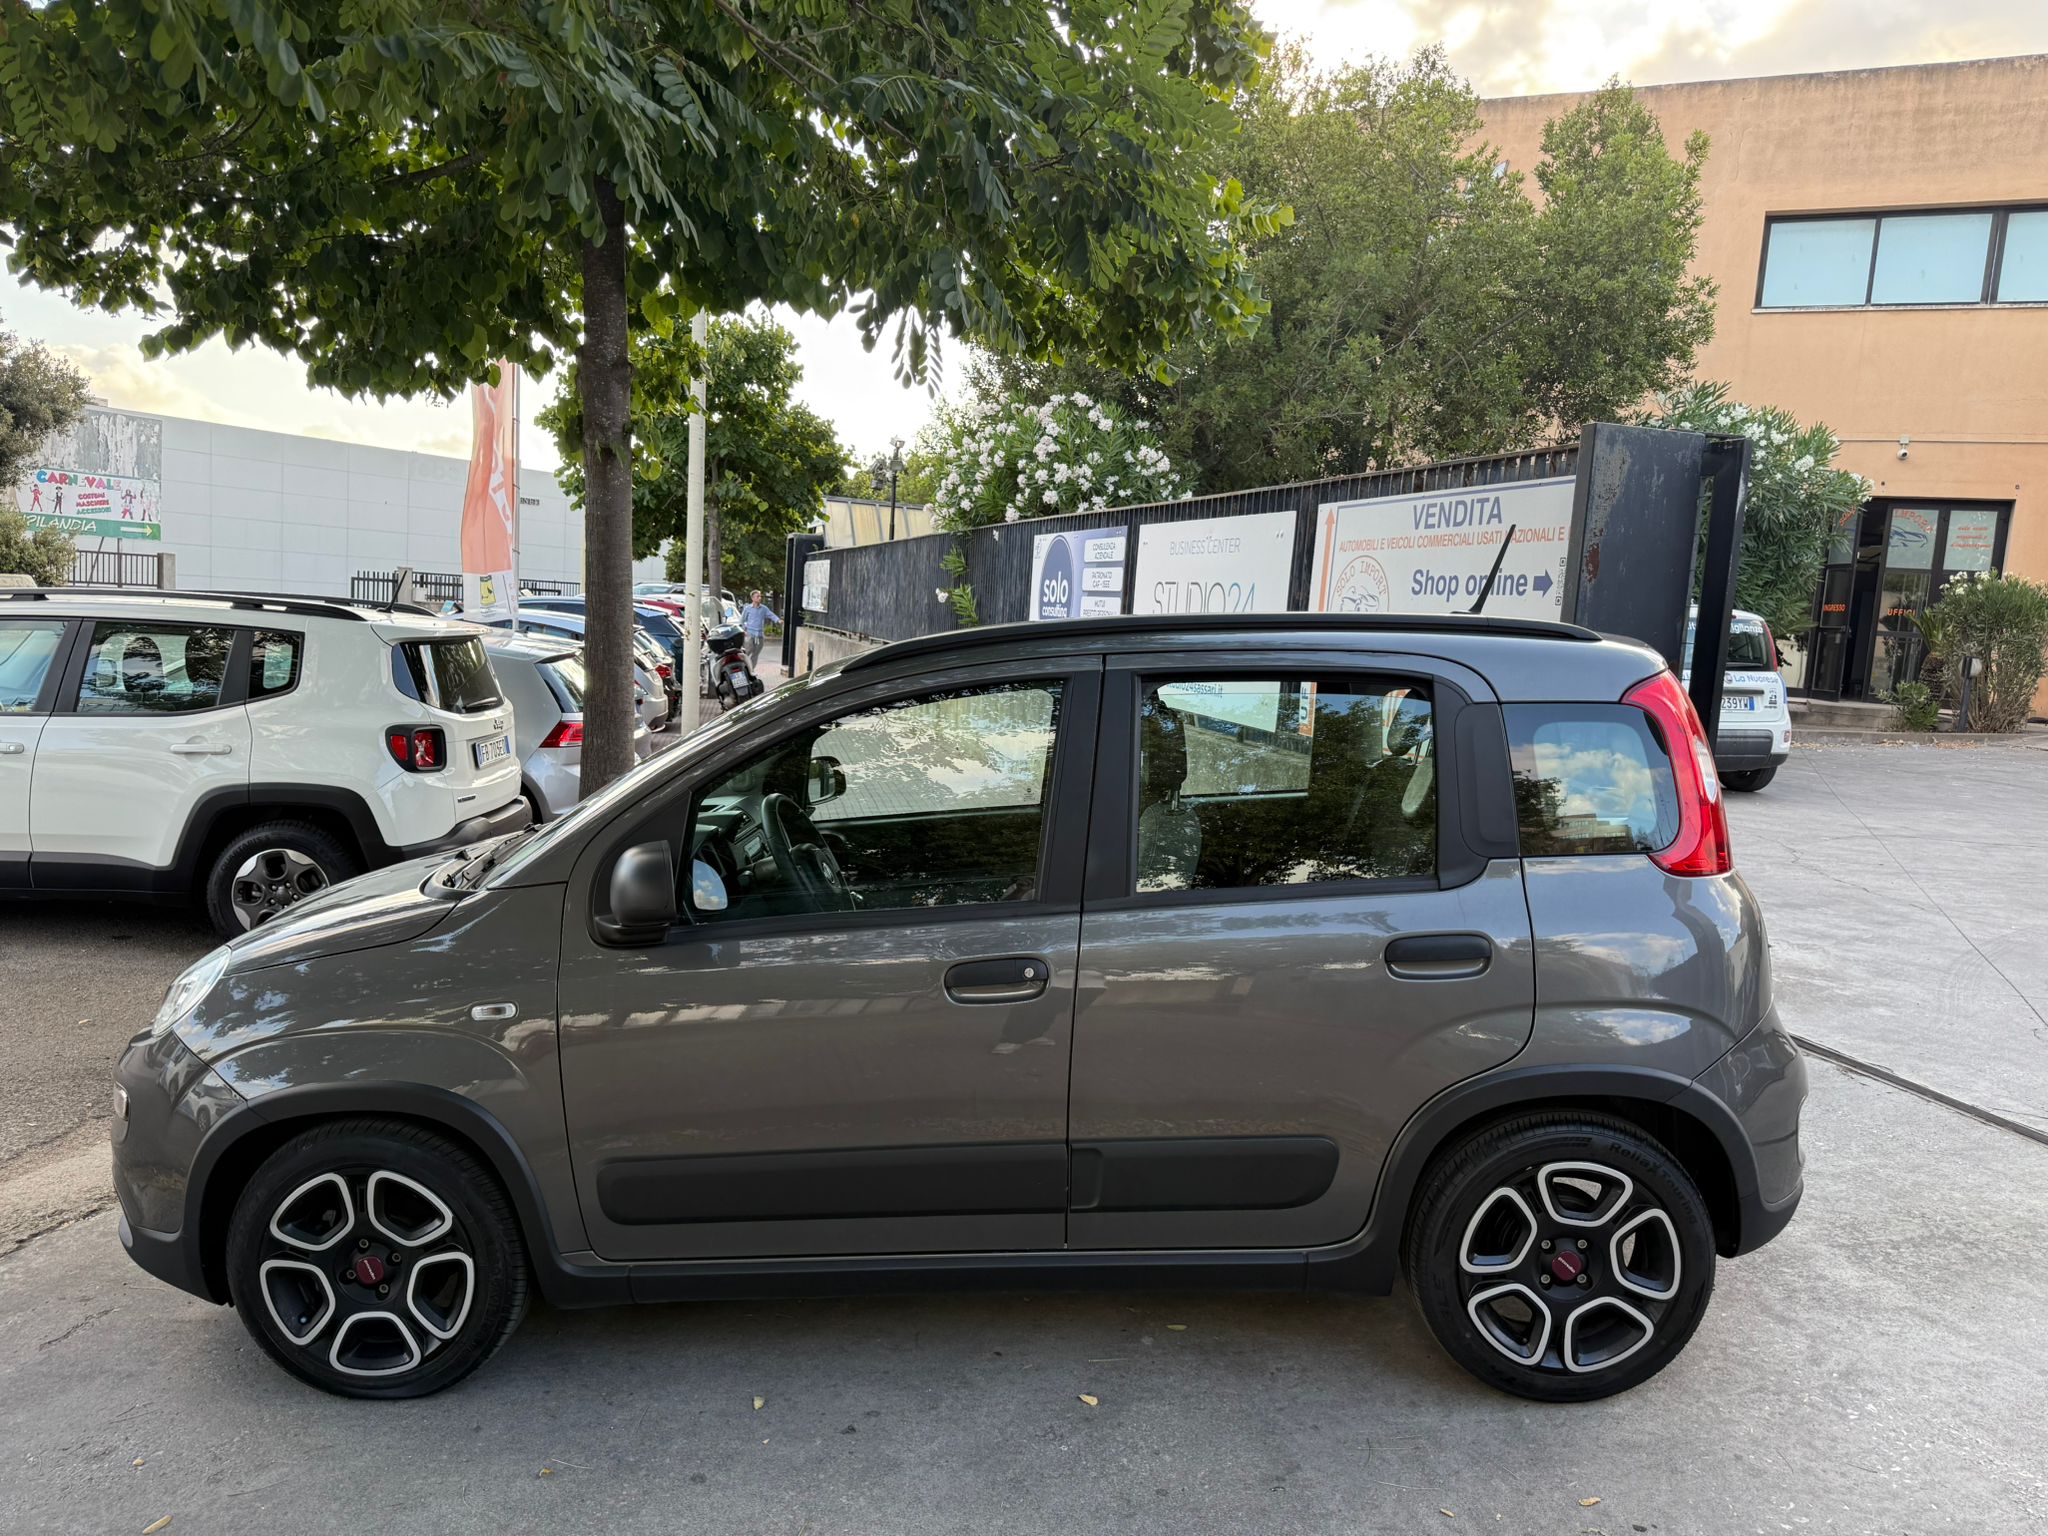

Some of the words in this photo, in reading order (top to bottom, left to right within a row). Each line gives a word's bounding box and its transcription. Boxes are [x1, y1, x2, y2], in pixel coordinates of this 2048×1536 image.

[36, 470, 121, 491] CARNEVALE
[1413, 496, 1502, 530] VENDITA
[1169, 540, 1206, 555] BUSINESS
[1207, 537, 1241, 554] CENTER
[1339, 539, 1379, 552] AUTOMOBILI
[1380, 539, 1386, 550] E
[1387, 536, 1416, 550] VEICOLI
[1417, 530, 1475, 548] COMMERCIALI
[1477, 530, 1501, 545] USATI
[1505, 526, 1555, 544] AZIONALI
[1558, 526, 1565, 541] E
[1043, 571, 1068, 603] solo
[1337, 565, 1355, 596] SOLO
[1360, 561, 1386, 596] IMPORT
[1411, 569, 1459, 602] Shop
[1465, 568, 1528, 596] onine
[1042, 604, 1068, 618] consulting
[1887, 608, 1916, 616] UFFICI
